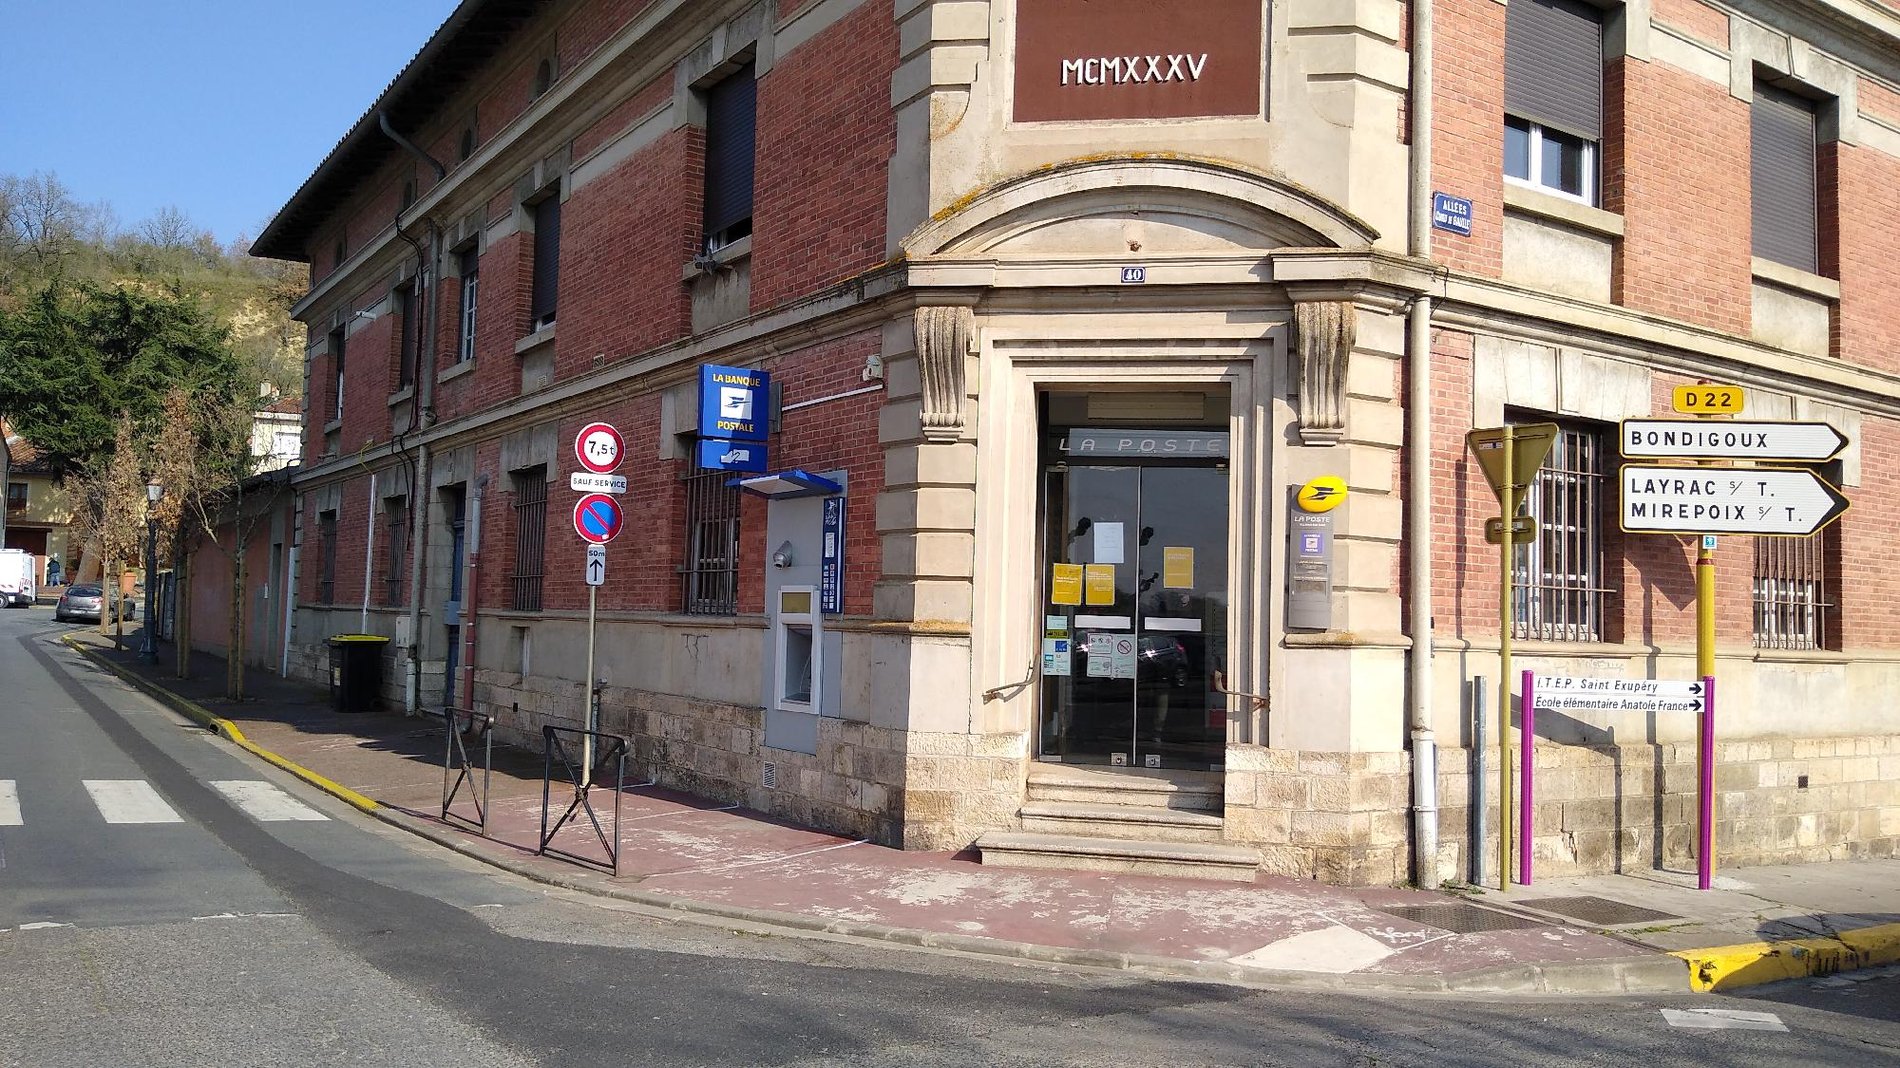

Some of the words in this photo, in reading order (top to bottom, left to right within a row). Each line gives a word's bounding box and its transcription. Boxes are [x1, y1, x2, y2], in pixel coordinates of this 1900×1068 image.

[1061, 53, 1208, 86] MCMXXXV
[1125, 269, 1141, 280] 40
[713, 373, 723, 383] LA
[725, 375, 761, 387] BANQUE
[1687, 392, 1697, 406] D
[1705, 392, 1732, 407] 22
[717, 420, 754, 432] POSTALE
[1058, 438, 1097, 451] LA
[1118, 439, 1223, 452] POSTE
[1631, 430, 1768, 448] BONDIGOUX
[573, 477, 593, 485] SAUF
[594, 479, 626, 489] SERVICE
[1631, 478, 1717, 495] LAYRAC
[1757, 482, 1775, 497] T.
[1631, 502, 1745, 520] MIREPOIX
[1785, 507, 1802, 522] T.
[1580, 678, 1609, 690] Saint
[1614, 680, 1659, 693] Exupéry
[1535, 694, 1562, 708] École
[1563, 697, 1619, 709] élémentaire
[1658, 700, 1689, 711] France
